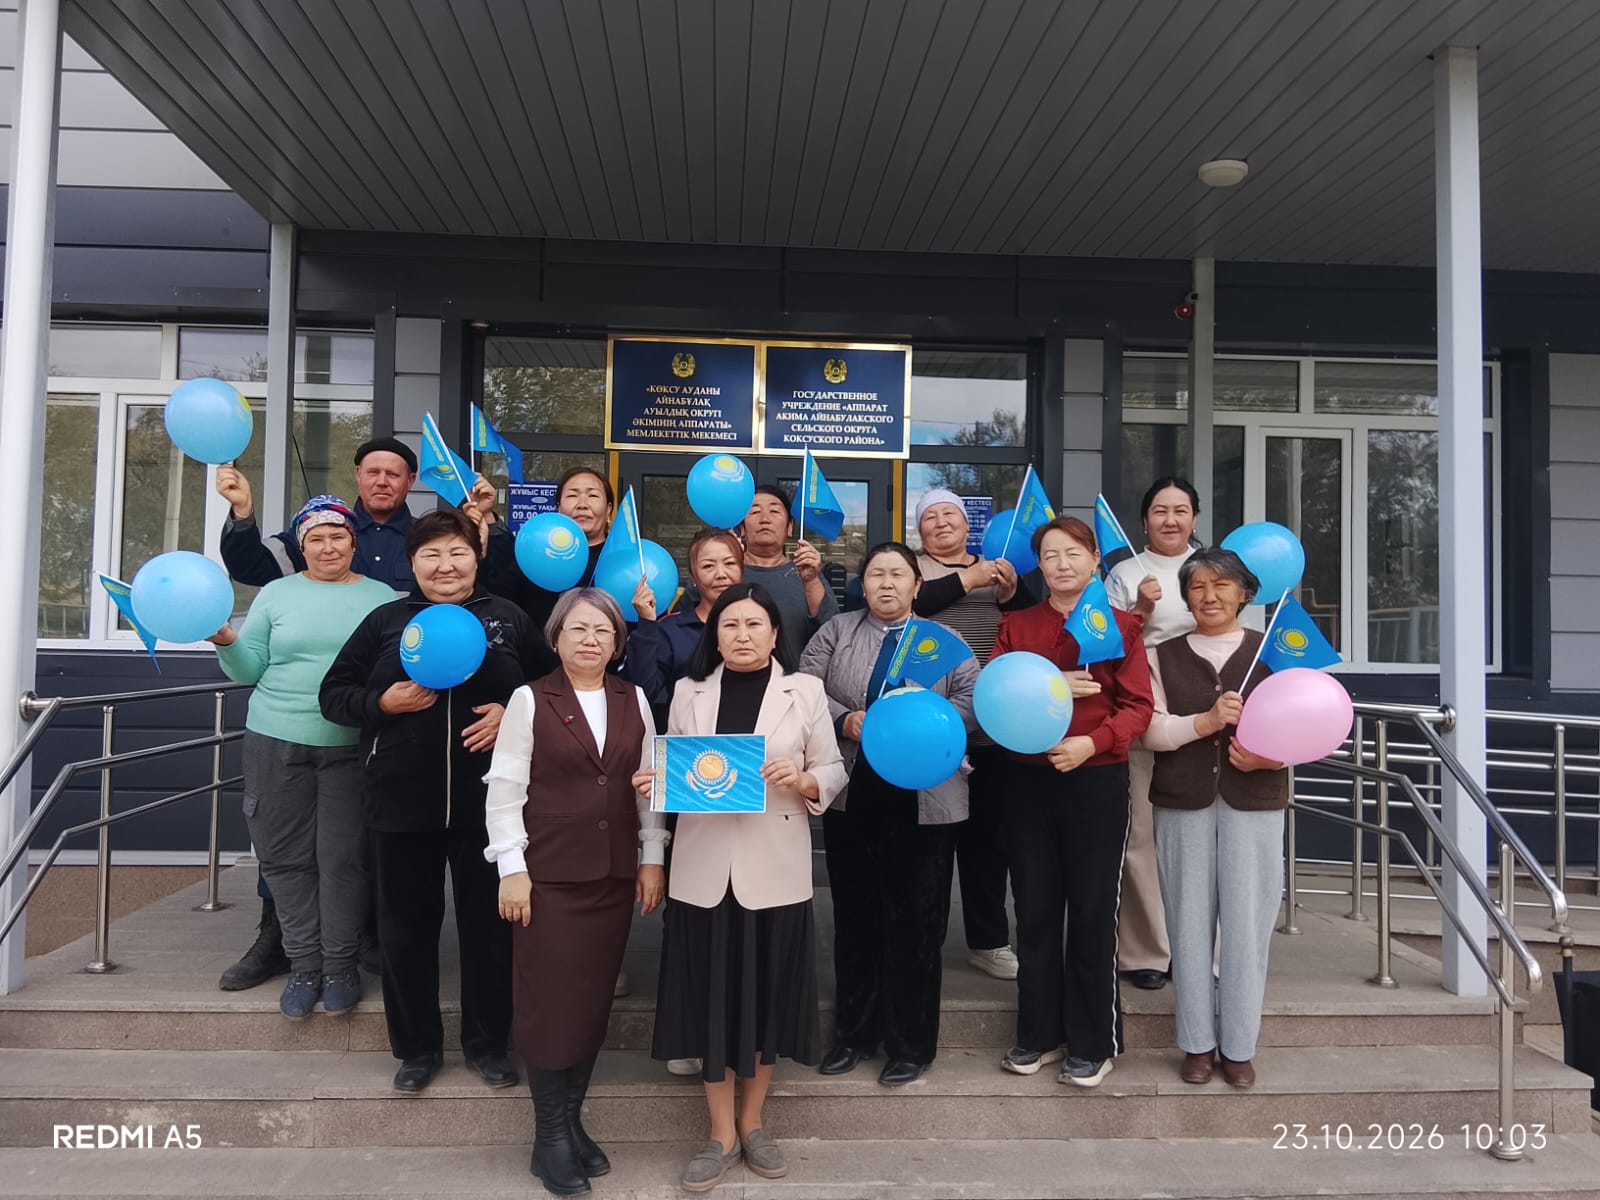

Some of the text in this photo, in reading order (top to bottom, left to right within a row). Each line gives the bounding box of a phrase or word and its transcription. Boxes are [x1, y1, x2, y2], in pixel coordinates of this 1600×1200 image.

[682, 387, 720, 395] АУДАНЫ
[793, 391, 878, 400] ГОСУДАРСТВЕННОЕ
[782, 402, 841, 410] УЧРЕЖДЕНИЕ
[644, 408, 721, 418] АУЫЛДЫҚ ОКРУГІ
[776, 412, 894, 423] АКИМА АЙНАБУЛАКСКОГО
[632, 418, 677, 427] ӘКІМІНІҢ
[791, 424, 878, 434] СЕЛЬСКОГО ОКРУГА
[626, 429, 737, 440] МЕМЛЕКЕТТІК МЕКЕМЕСІ
[783, 434, 842, 443] КОКСУСКОГО
